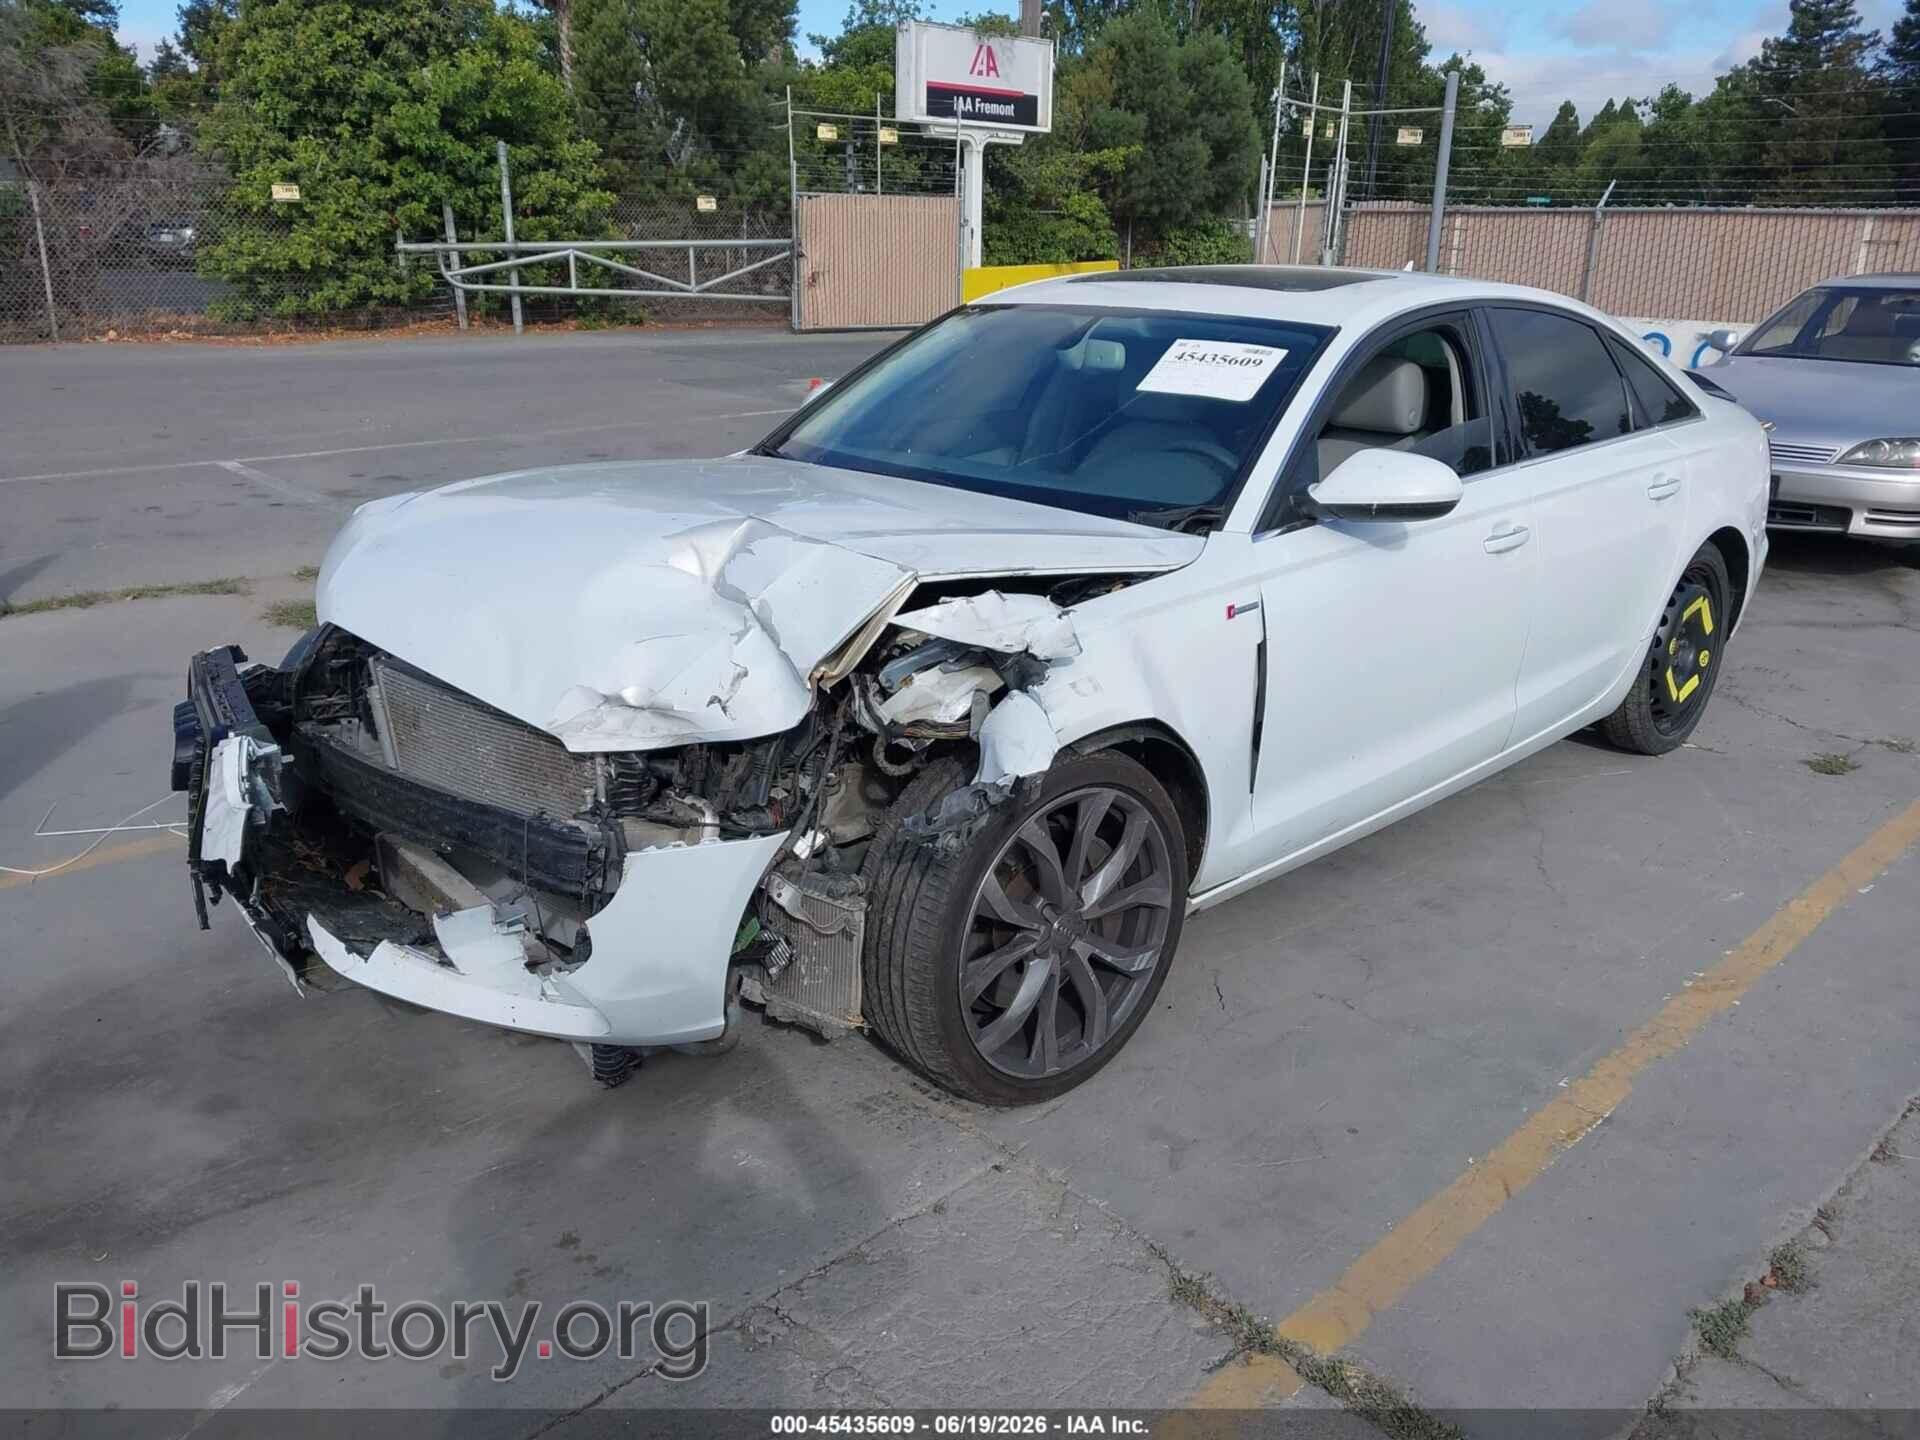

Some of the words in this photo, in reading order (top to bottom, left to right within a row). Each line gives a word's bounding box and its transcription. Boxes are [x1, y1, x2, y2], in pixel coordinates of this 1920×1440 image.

[953, 95, 973, 113] IAA
[975, 98, 1015, 117] Fremont
[1175, 351, 1263, 367] 45435609
